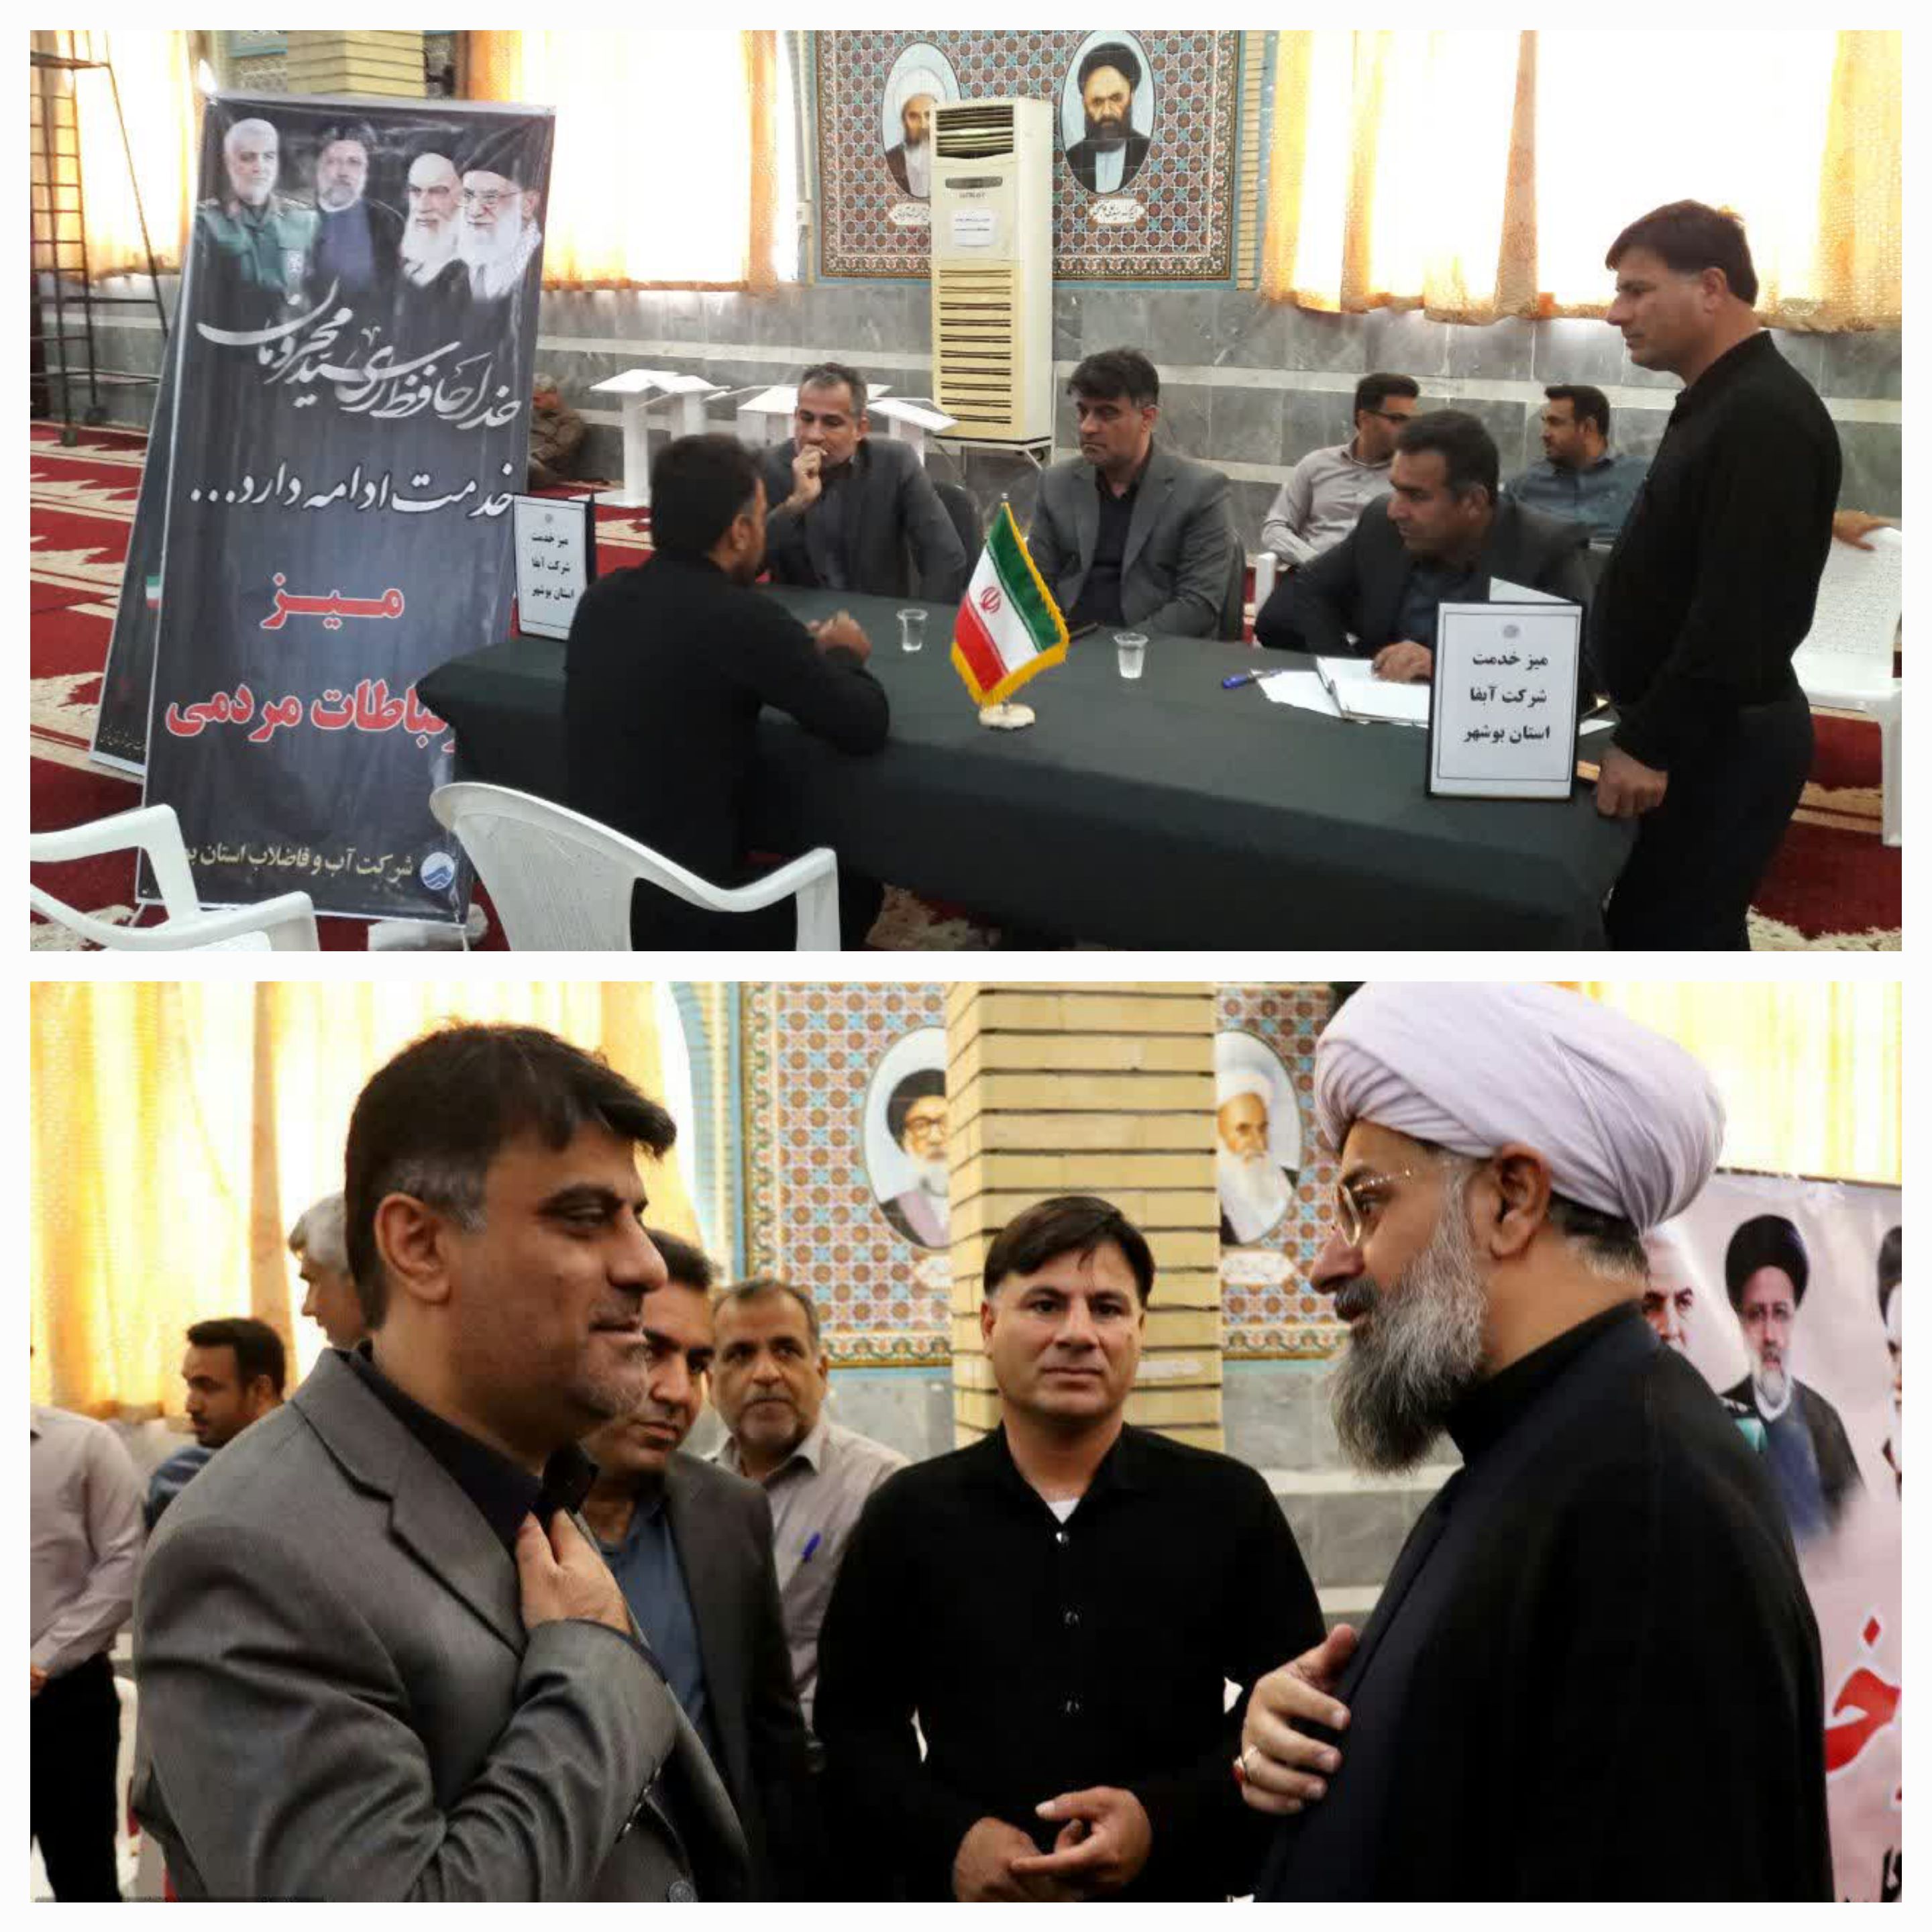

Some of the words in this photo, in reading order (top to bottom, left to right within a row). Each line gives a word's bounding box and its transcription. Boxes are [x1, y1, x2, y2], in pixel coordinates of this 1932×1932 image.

[304, 466, 388, 510] ادامه
[392, 463, 515, 518] خدمت
[261, 574, 405, 630] میز
[1472, 651, 1521, 666] خدمت
[1525, 653, 1549, 670] میز
[1469, 686, 1498, 706] آبفا
[1501, 688, 1548, 708] شرکت
[165, 683, 303, 743] مردمی
[1463, 724, 1505, 743] بوشهر
[1509, 724, 1551, 745] استان
[200, 842, 246, 865] استان
[248, 843, 310, 871] فاضلاب
[311, 854, 322, 875] و
[325, 848, 356, 877] آب
[356, 853, 414, 883] شرکت
